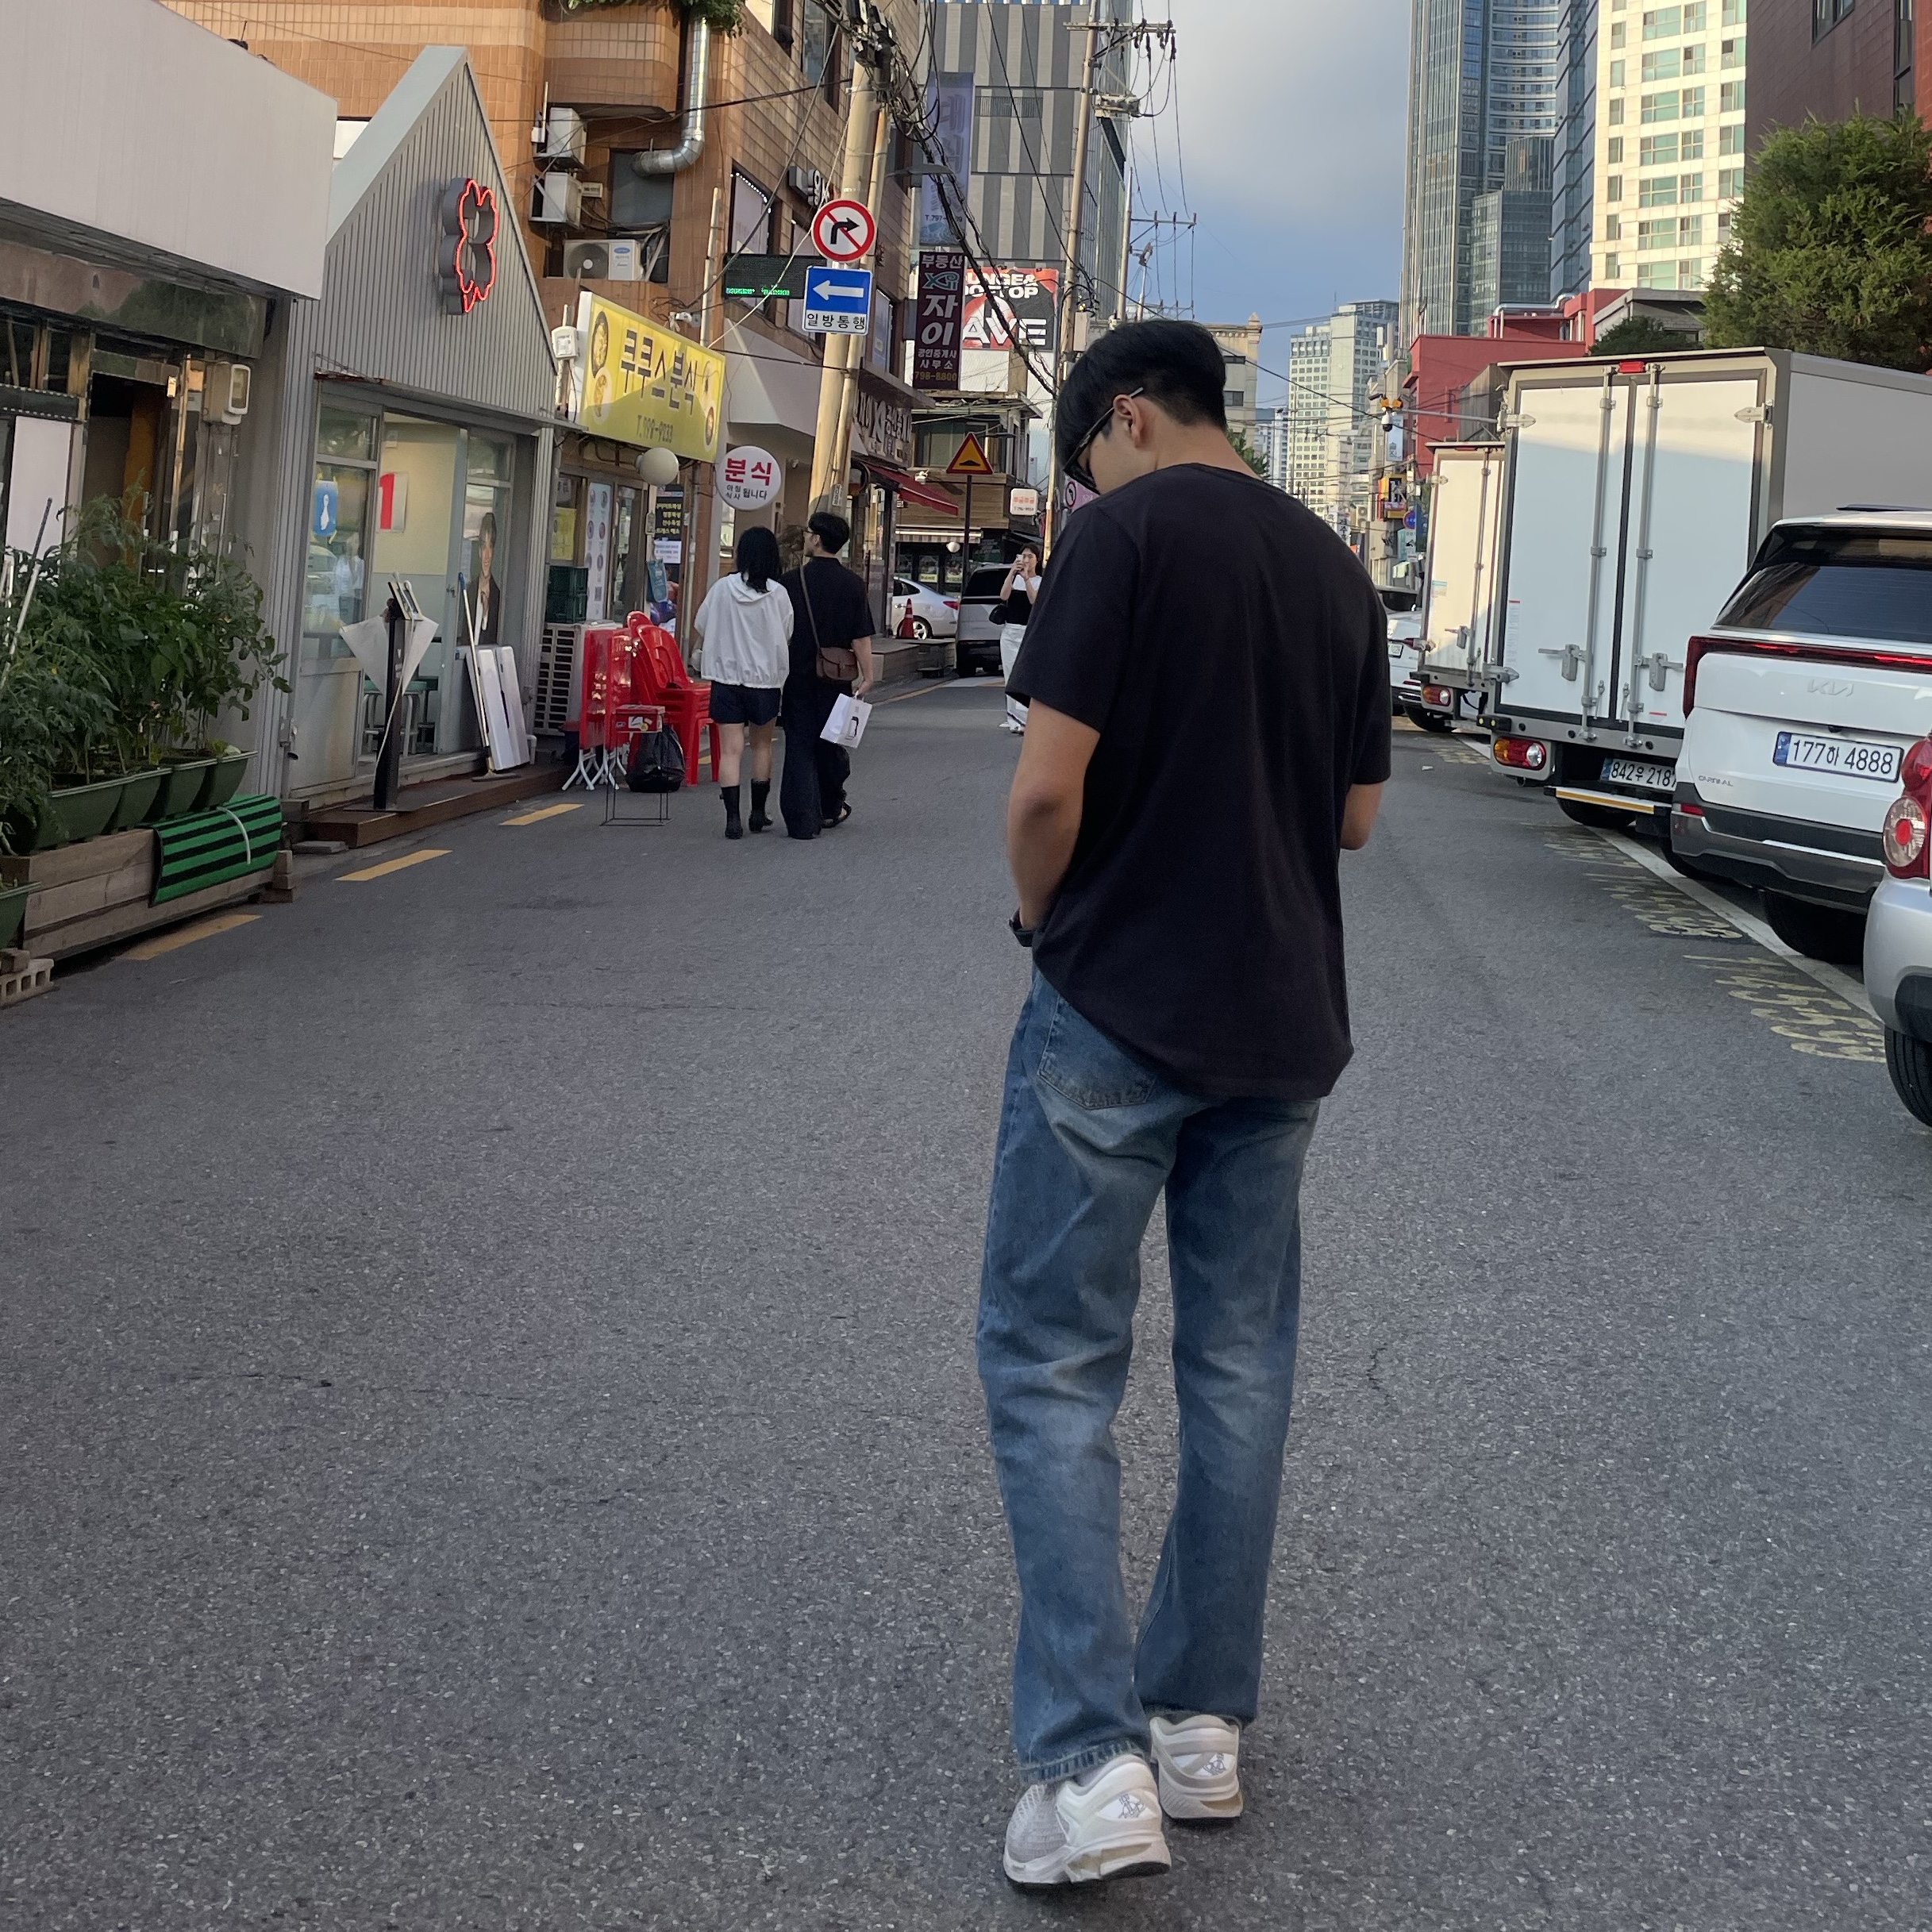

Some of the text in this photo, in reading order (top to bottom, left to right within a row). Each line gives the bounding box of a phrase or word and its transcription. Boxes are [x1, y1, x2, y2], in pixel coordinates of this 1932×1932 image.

[922, 255, 963, 268] 부동산
[965, 272, 1038, 287] UNGE&
[806, 313, 865, 329] 일방통행
[919, 360, 953, 370] 사무소
[725, 458, 772, 487] 분식
[742, 487, 768, 500] 됩니다
[1792, 740, 1894, 775] 177하 4888
[1611, 763, 1644, 782] 842우
